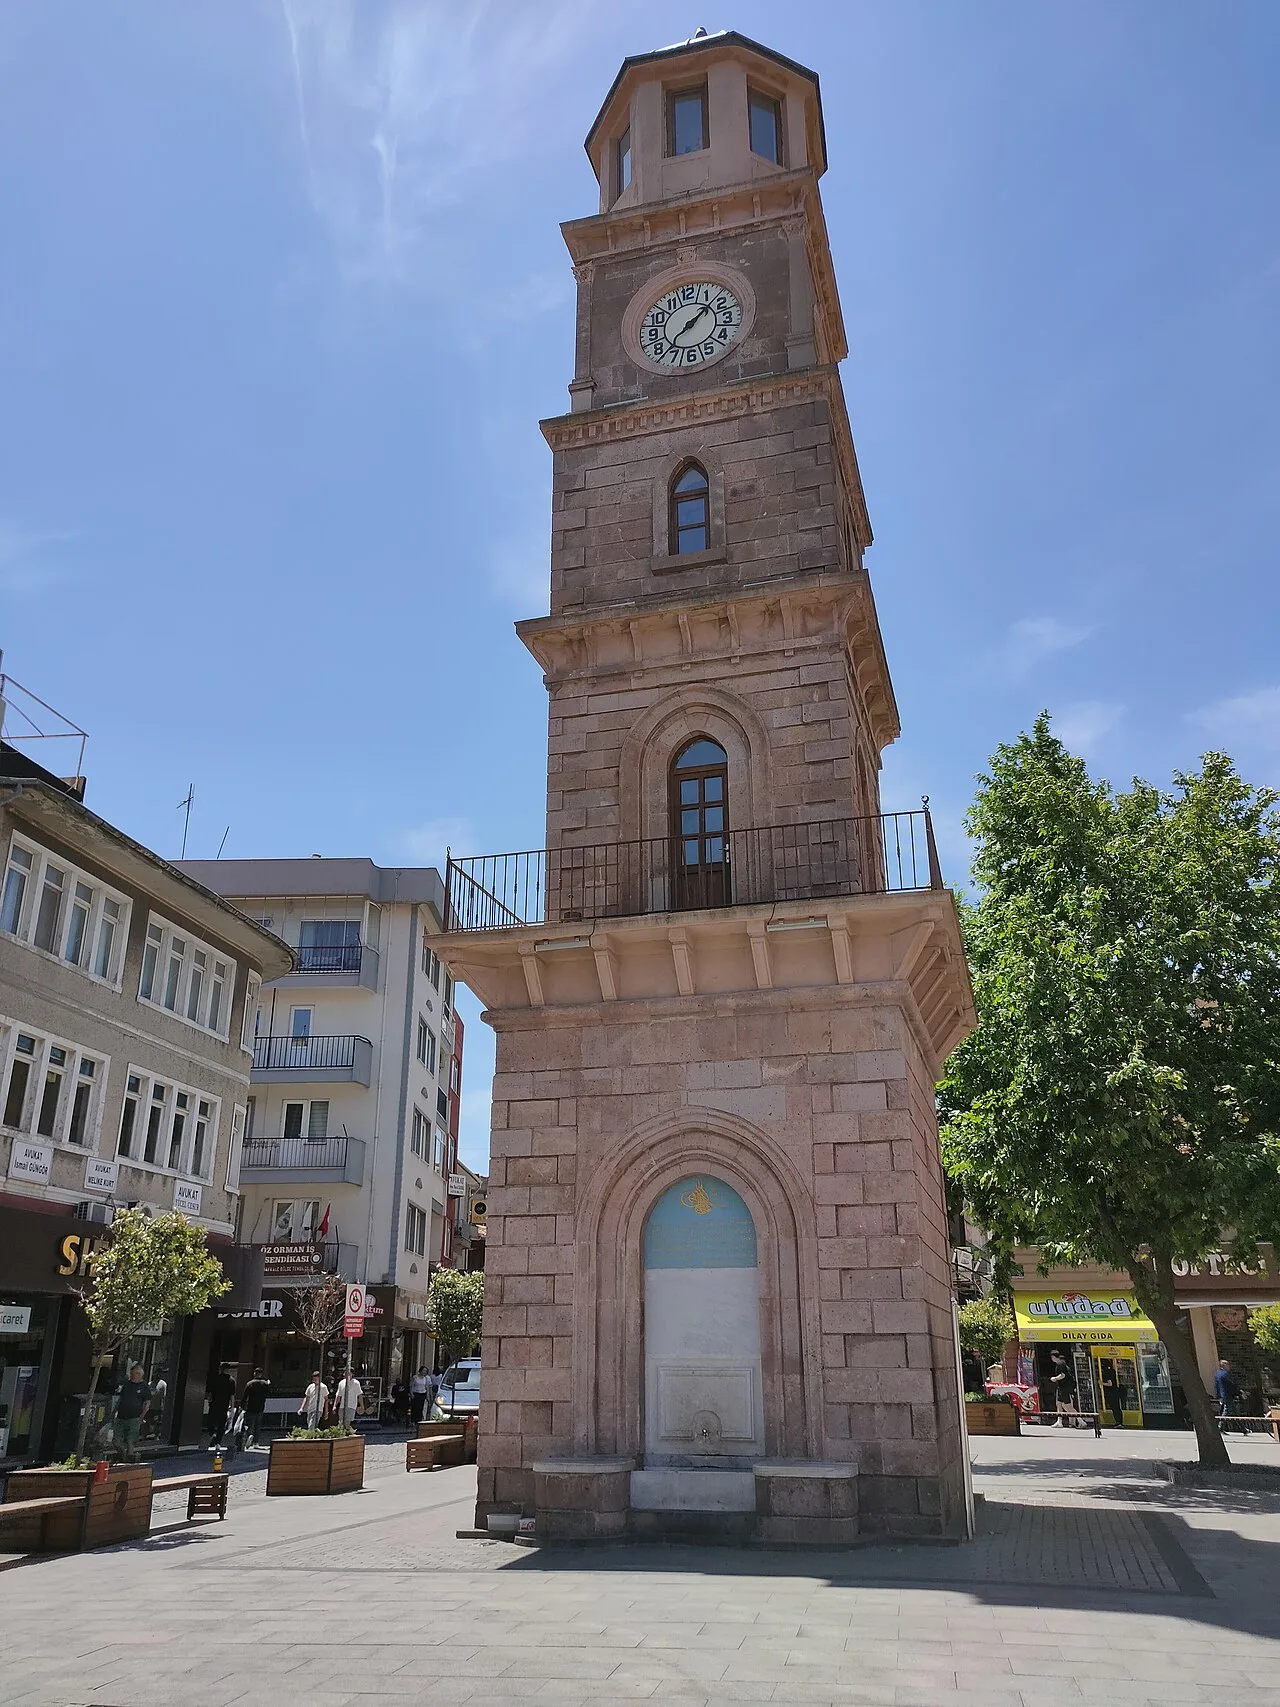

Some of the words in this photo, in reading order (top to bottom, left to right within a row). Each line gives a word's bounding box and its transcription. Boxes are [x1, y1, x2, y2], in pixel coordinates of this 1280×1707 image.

[681, 287, 695, 301] 12
[703, 289, 709, 301] 1
[667, 297, 677, 310] 11
[716, 296, 727, 310] 2
[650, 312, 665, 326] 10
[722, 311, 733, 324] 3
[648, 328, 659, 341] 9
[717, 328, 728, 340] 4
[653, 342, 664, 355] 8
[703, 341, 714, 355] 5
[669, 349, 680, 363] 7
[686, 349, 697, 362] 6
[24, 1148, 43, 1161] AVUKAT
[28, 1162, 48, 1176] GÜNGÖR
[94, 1165, 112, 1174] AVUKAT
[103, 1178, 115, 1188] KURT
[178, 1186, 199, 1200] AVUKAT
[260, 1244, 272, 1254] ÖZ
[273, 1245, 305, 1254] ORMAN
[306, 1244, 316, 1255] İŞ
[264, 1255, 310, 1264] SENDİKASI
[1029, 1297, 1133, 1317] uludağ
[1062, 1331, 1088, 1340] DİLAY
[1090, 1332, 1113, 1340] GIDA
